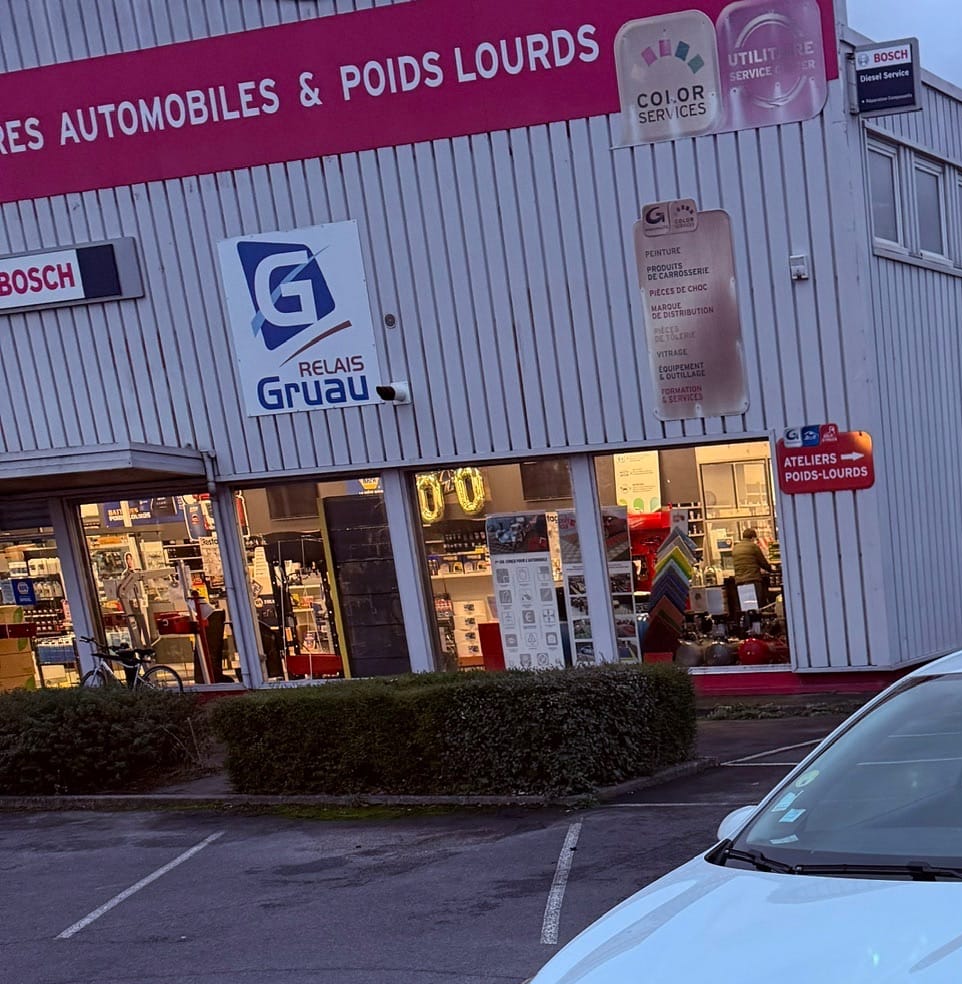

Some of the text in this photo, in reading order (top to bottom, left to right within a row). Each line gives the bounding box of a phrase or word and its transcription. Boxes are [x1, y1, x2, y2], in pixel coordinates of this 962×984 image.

[874, 49, 908, 63] BOSCH
[729, 66, 773, 82] SERVICE
[860, 69, 910, 83] Diesel Service
[60, 78, 280, 146] AUTOMOBILES
[300, 71, 322, 108] &
[340, 51, 443, 101] POIDS
[454, 23, 600, 84] LOURDS
[637, 85, 704, 109] COLOR
[638, 102, 706, 124] SERVICES
[645, 247, 681, 258] PEINTURE
[646, 262, 683, 274] PRODUITS
[648, 267, 709, 281] DE CARROSSERIE
[0, 262, 76, 297] BOSCH
[676, 286, 687, 294] DE
[688, 284, 708, 292] CHOC
[651, 302, 682, 312] MARQUE
[652, 307, 714, 320] DE DISTRIBUTION
[657, 348, 688, 358] VITRAGE
[299, 355, 364, 378] RELAIS
[666, 370, 706, 380] OUTILLAGE
[257, 375, 370, 411] Gruau
[662, 385, 702, 396] FORMATION
[784, 453, 837, 468] ATELIERS
[785, 466, 869, 482] POIDS-LOURDS
